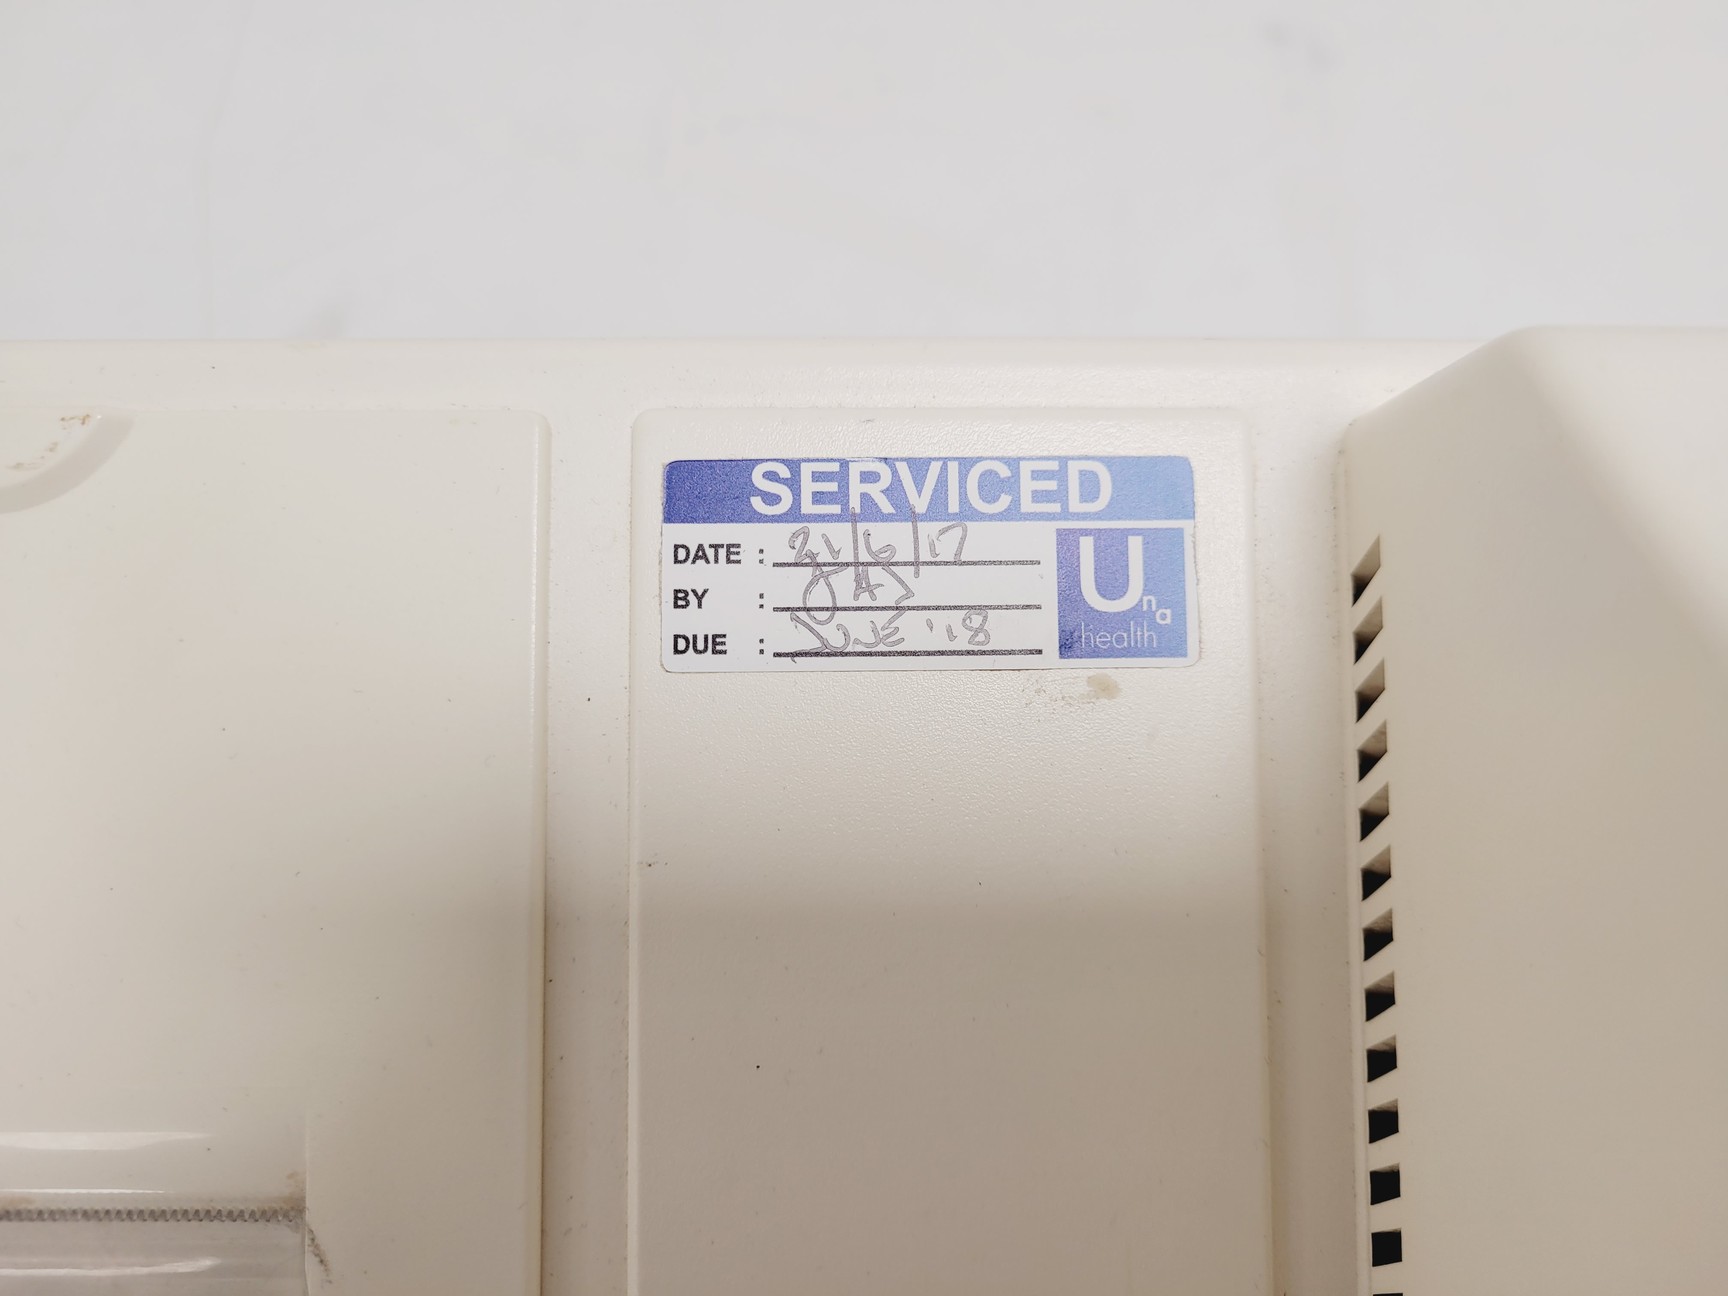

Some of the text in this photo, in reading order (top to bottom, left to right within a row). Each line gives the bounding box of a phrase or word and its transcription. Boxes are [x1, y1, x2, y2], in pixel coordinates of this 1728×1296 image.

[749, 461, 1113, 515] SERVICED
[672, 543, 742, 565] DATE
[788, 507, 969, 578] 21/6/17
[672, 588, 710, 609] BY
[672, 634, 728, 656] DUE
[1081, 620, 1158, 650] health
